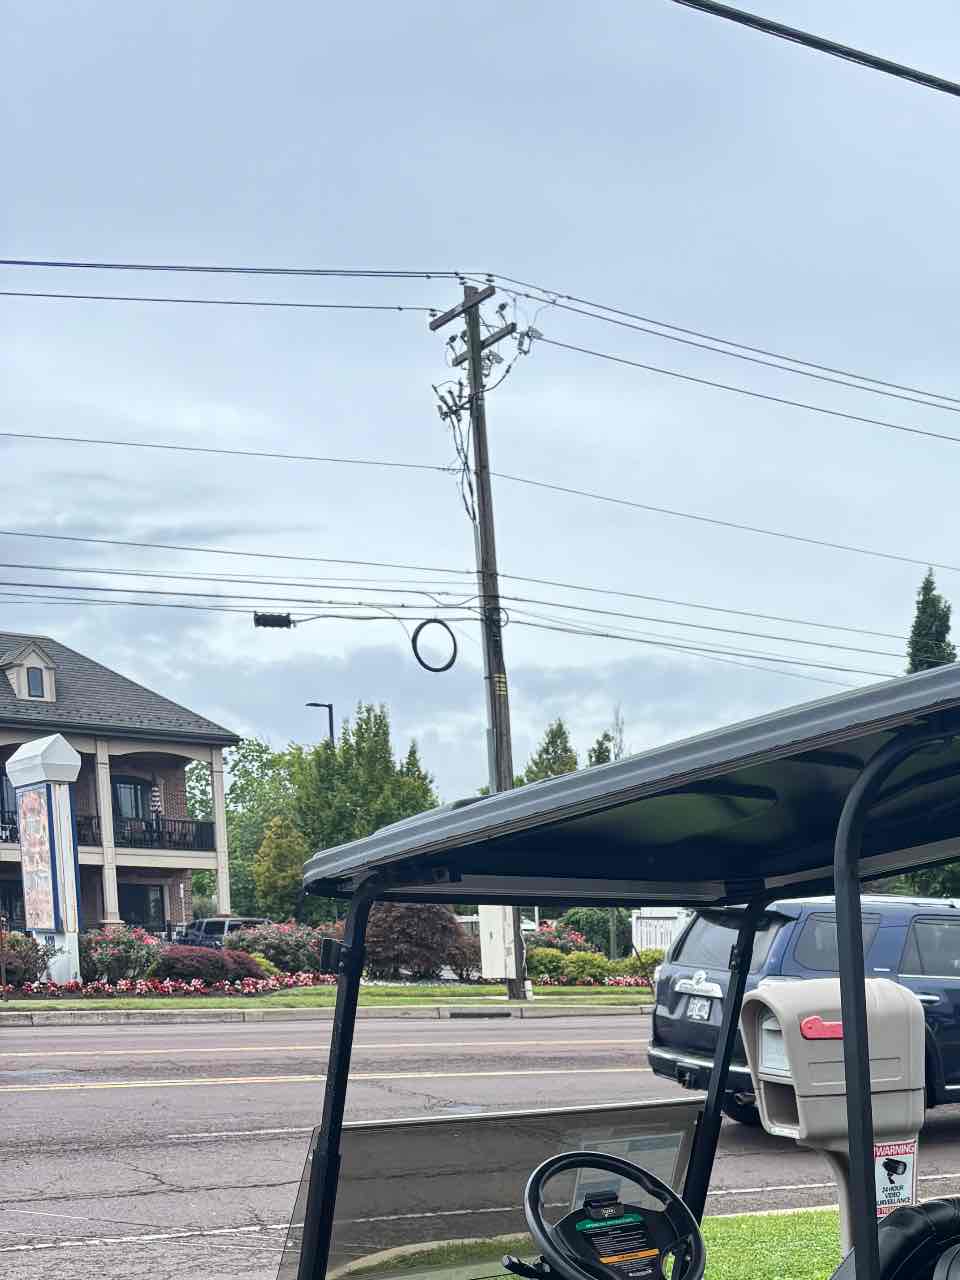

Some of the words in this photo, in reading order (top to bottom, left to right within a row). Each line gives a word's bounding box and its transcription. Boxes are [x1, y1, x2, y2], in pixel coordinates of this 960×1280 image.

[875, 1143, 915, 1156] WARNING
[889, 1184, 904, 1192] HOUR
[884, 1191, 901, 1199] VIDEO
[876, 1197, 911, 1206] URVEILLANCE
